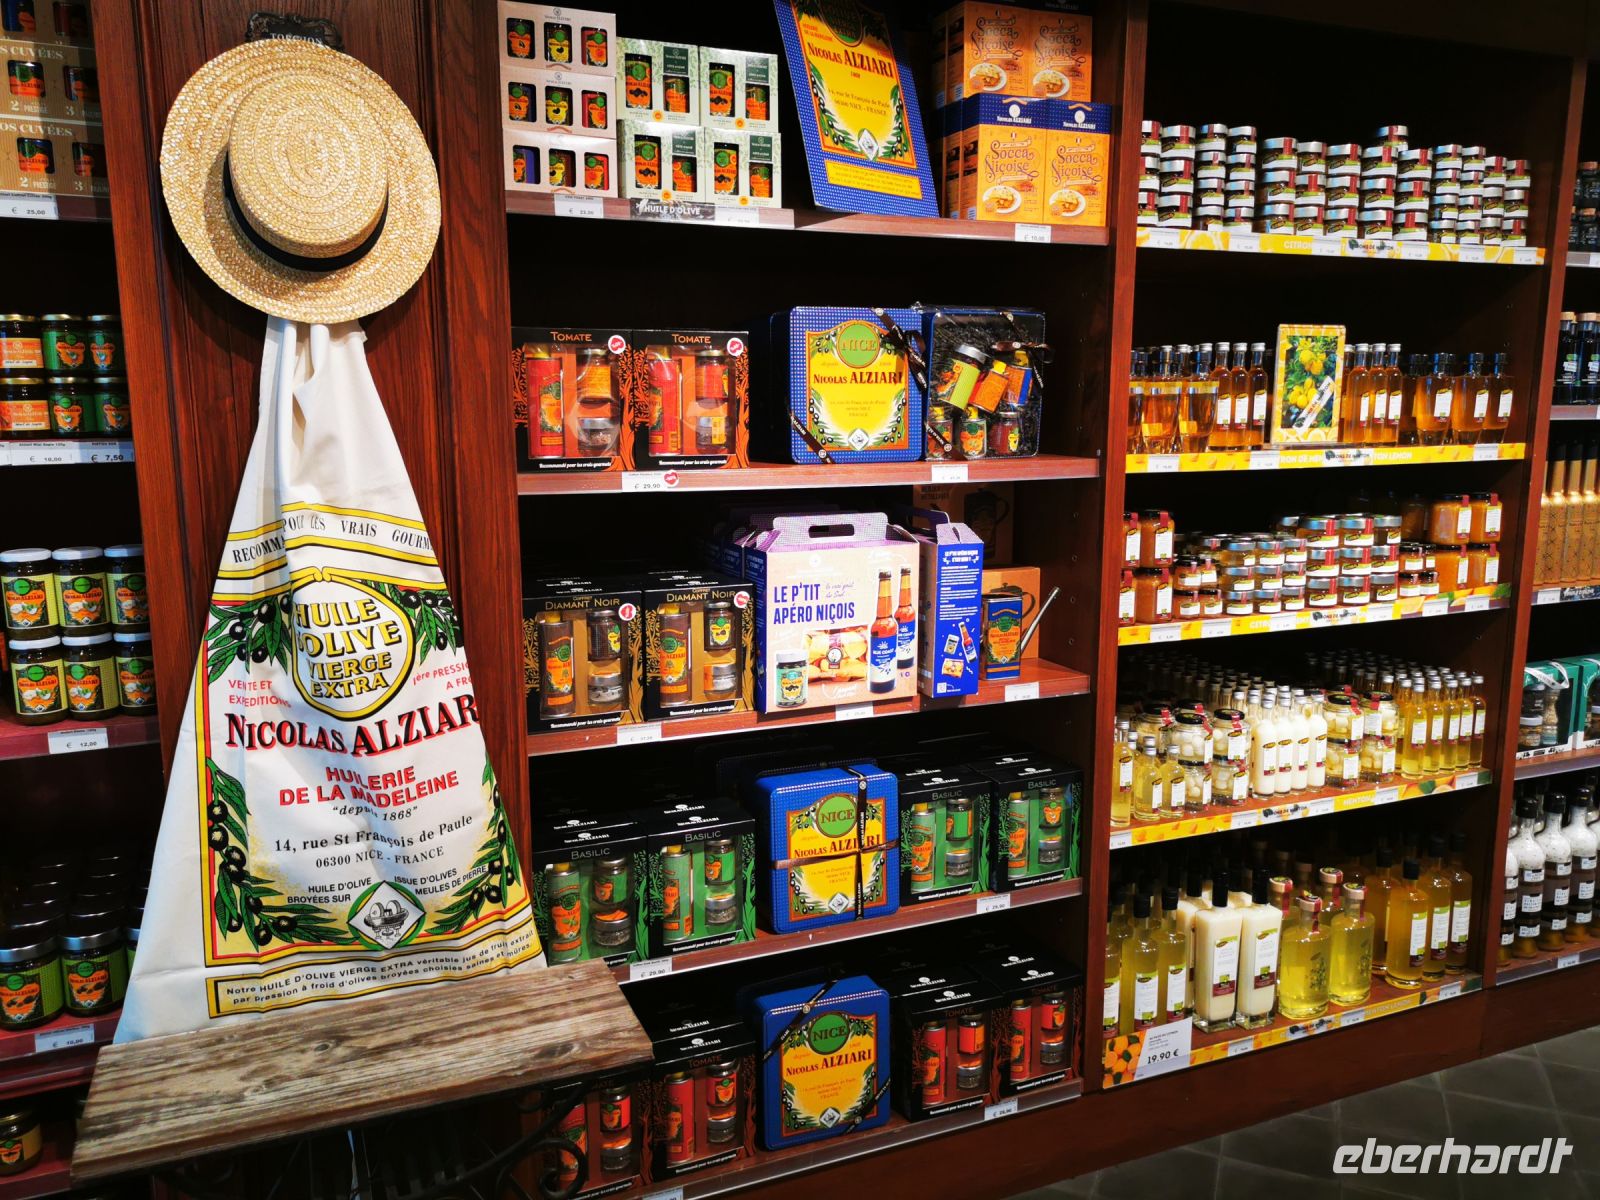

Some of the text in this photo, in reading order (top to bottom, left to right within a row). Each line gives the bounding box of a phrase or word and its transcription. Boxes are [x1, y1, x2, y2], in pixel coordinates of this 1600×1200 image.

[807, 42, 895, 79] NICOLAS ALZIARI
[19, 124, 73, 136] CUVÉES
[990, 140, 1035, 161] Socca
[1056, 145, 1098, 165] Socca
[985, 155, 1040, 183] Niçoise
[1051, 160, 1103, 187] Niçoise
[644, 203, 701, 215] HUILE D'OLIVE
[550, 331, 593, 343] TOMATE
[671, 333, 712, 345] TOMATE
[813, 371, 904, 385] NICOLAS ALZIARI
[91, 454, 124, 463] € 7,50
[340, 519, 378, 538] VRAIS
[391, 528, 434, 552] GOURM
[666, 589, 737, 603] DIAMANT NOIR
[773, 581, 820, 603] LE P'TIT
[293, 598, 381, 629] HUILE
[544, 598, 621, 611] DIAMANT NOIR
[773, 601, 855, 625] APÉRO NIÇOIS
[307, 651, 393, 682] VIERGE
[259, 680, 273, 691] ET
[309, 672, 392, 700] EXTRA
[446, 680, 455, 691] A
[224, 712, 348, 755] NICOLAS
[325, 765, 417, 792] HUILERIE
[1027, 779, 1057, 790] BASILIC
[279, 769, 460, 809] DE LA MADELEINE
[931, 790, 963, 801] BASILIC
[821, 809, 855, 824] NICE
[274, 814, 474, 855] 14, rue St François de Paule
[684, 830, 721, 843] BASILIC
[570, 847, 611, 860] BASILIC
[794, 834, 881, 859] NICOLAS ALZIRI
[315, 854, 352, 869] 06300
[354, 849, 384, 864] NICE
[394, 845, 445, 866] FRANCE
[308, 876, 373, 894] HUILE D'OLIVE
[394, 867, 458, 887] ISSUE D'OLIVES
[414, 864, 487, 896] MEULES DE PIERRE
[286, 893, 352, 904] BROYÉES SUR
[226, 986, 257, 996] Notre
[259, 979, 291, 993] HUILE
[294, 972, 336, 983] D'OLIVE
[339, 966, 378, 978] VIERGE
[380, 960, 414, 973] EXTRA
[417, 954, 460, 966] véritable
[462, 953, 477, 965] jus
[479, 948, 489, 957] de
[510, 930, 535, 947] extrait
[232, 995, 251, 1006] par
[253, 987, 299, 1003] pression
[301, 984, 308, 992] à
[311, 980, 336, 989] froid
[338, 974, 378, 989] d'olives
[379, 968, 421, 982] broyées
[422, 965, 463, 974] choisies
[466, 956, 495, 970] saines
[496, 949, 505, 959] et
[944, 1007, 974, 1017] TOMATE
[812, 1026, 847, 1042] NICE
[689, 1055, 722, 1069] TOMATE
[786, 1048, 872, 1077] NICOLAS ALZIARI
[1173, 1048, 1179, 1057] €
